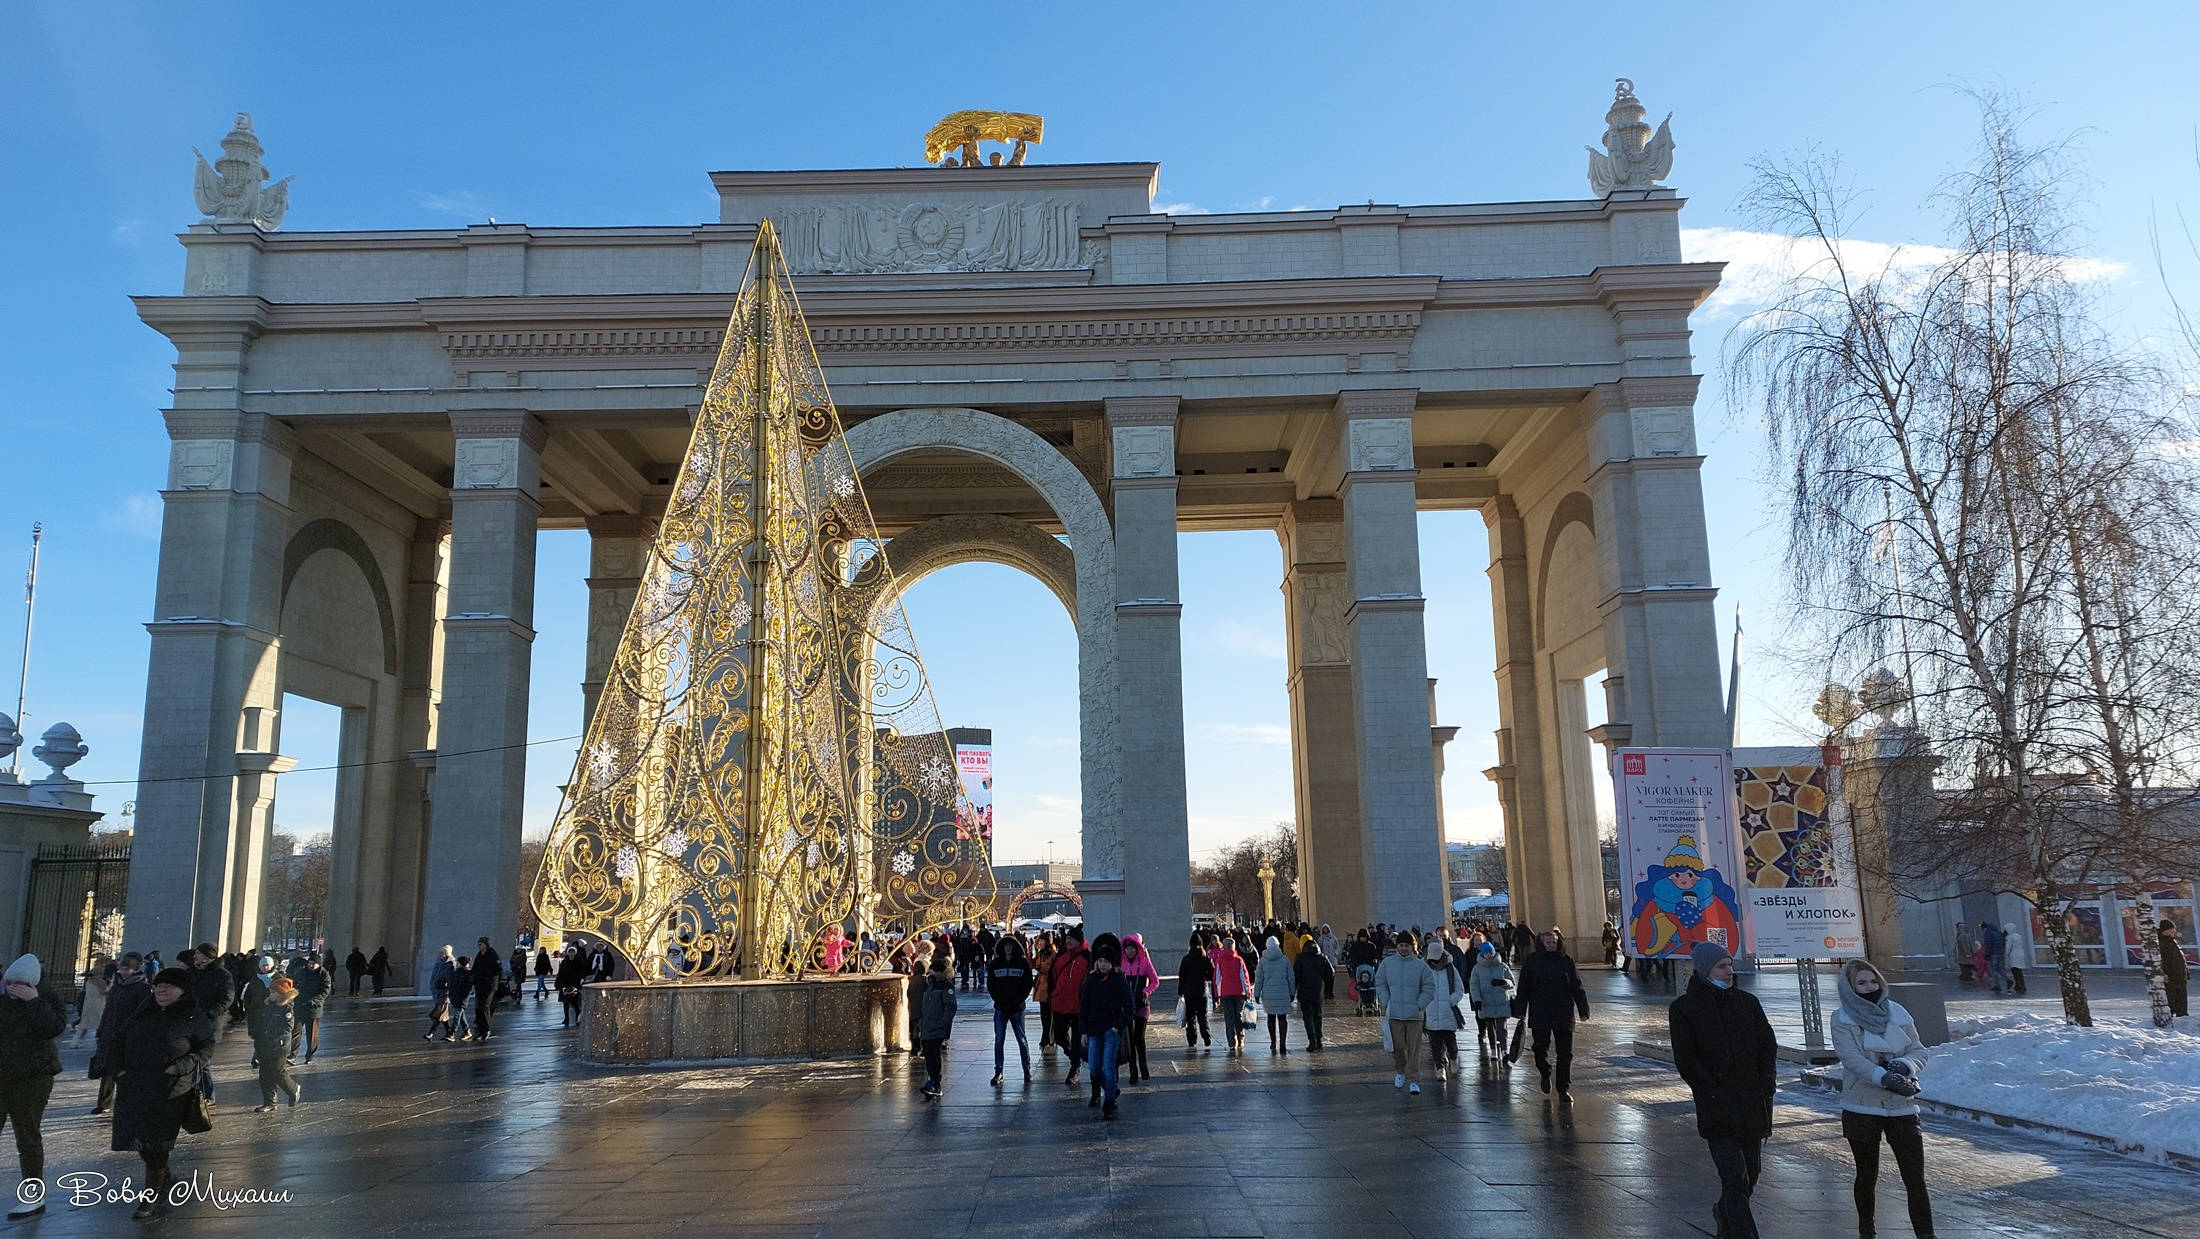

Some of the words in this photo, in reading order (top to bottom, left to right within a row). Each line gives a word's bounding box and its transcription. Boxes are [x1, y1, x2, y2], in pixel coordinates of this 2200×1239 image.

[1636, 786, 1672, 796] VIGOR
[1674, 786, 1713, 796] MAKER
[1656, 797, 1695, 805] КОФЕЙНЯ
[1754, 895, 1807, 907] «ЗВЁЗДЫ
[1785, 910, 1794, 919] И
[1797, 909, 1856, 919] ХЛОПОК»
